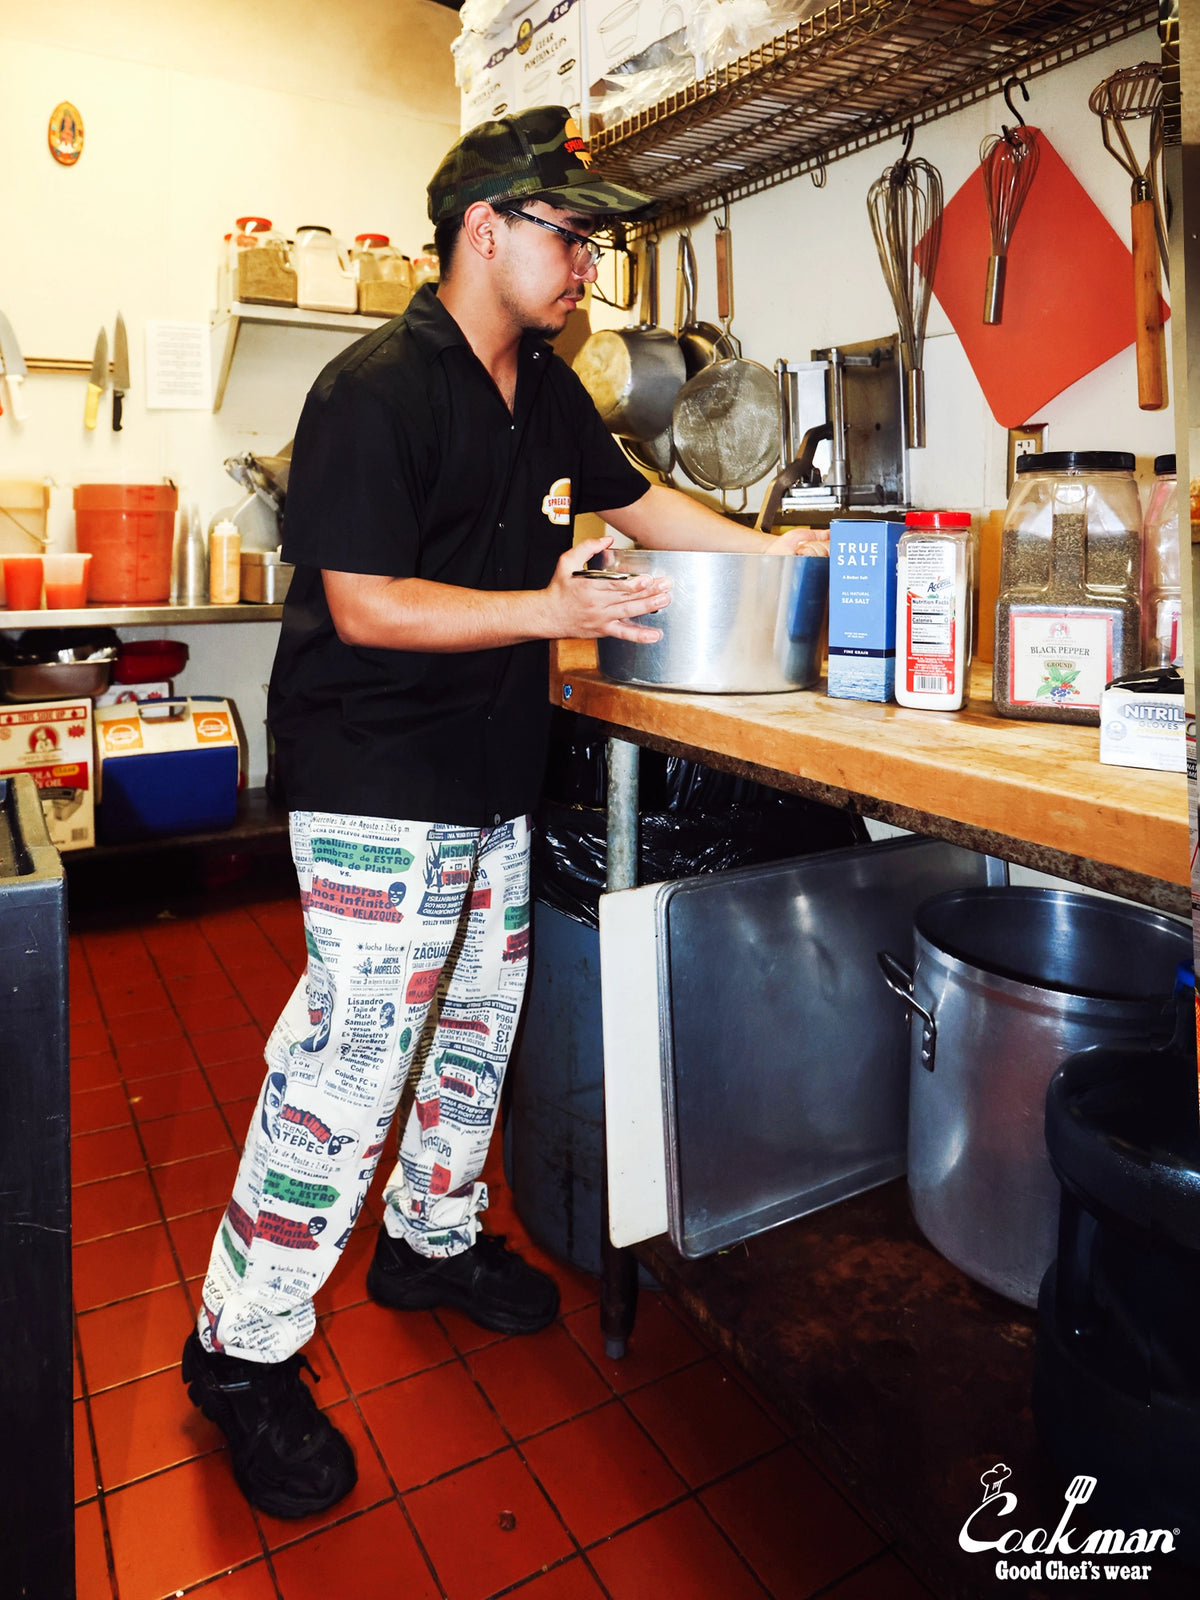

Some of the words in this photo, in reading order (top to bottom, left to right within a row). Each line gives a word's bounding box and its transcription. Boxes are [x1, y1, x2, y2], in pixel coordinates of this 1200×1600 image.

[837, 542, 879, 554] TRUE
[837, 554, 879, 566] SALT
[1030, 645, 1057, 655] BLACK
[1058, 646, 1090, 656] PEPPER
[1046, 661, 1073, 670] GROUND
[1124, 705, 1186, 722] NITRIL
[1138, 720, 1180, 730] GLOVES
[362, 844, 402, 856] GARCIA
[441, 844, 474, 858] FANTASM
[314, 856, 344, 869] ometa
[347, 862, 362, 871] de
[365, 863, 393, 875] Plata
[360, 855, 371, 863] de
[373, 855, 411, 867] ESTRO
[339, 870, 353, 878] vs.
[445, 870, 470, 886] TIGRE
[321, 877, 384, 898] Sombras
[338, 892, 393, 910] Infinito
[423, 902, 435, 910] LOS
[351, 907, 403, 923] VELAZQUEZ
[412, 946, 452, 960] ZACUAL
[373, 965, 401, 975] MORELOS
[347, 997, 385, 1006] Lisandro
[344, 1018, 378, 1026] Samuelo
[471, 1014, 490, 1024] 8:30
[496, 1013, 513, 1024] 1964
[438, 1019, 488, 1034] GUADALAJ
[351, 1031, 384, 1039] Siniestro
[447, 1029, 487, 1042] PRESENTADO
[496, 1030, 510, 1043] 13
[490, 1041, 508, 1053] VIE.
[443, 1054, 484, 1075] FANTASM
[358, 1077, 370, 1086] FC
[443, 1078, 473, 1098] TIGRE
[457, 1103, 488, 1115] DIABLOS
[301, 1113, 332, 1144] LIBRE
[282, 1131, 325, 1155] TEPEC
[289, 1178, 329, 1193] GARCIA
[298, 1188, 336, 1203] ESTRO
[288, 1197, 316, 1209] Plata
[258, 1210, 303, 1229] mbras
[259, 1220, 310, 1239] Infinito
[269, 1233, 319, 1250] VELAZQUEZ
